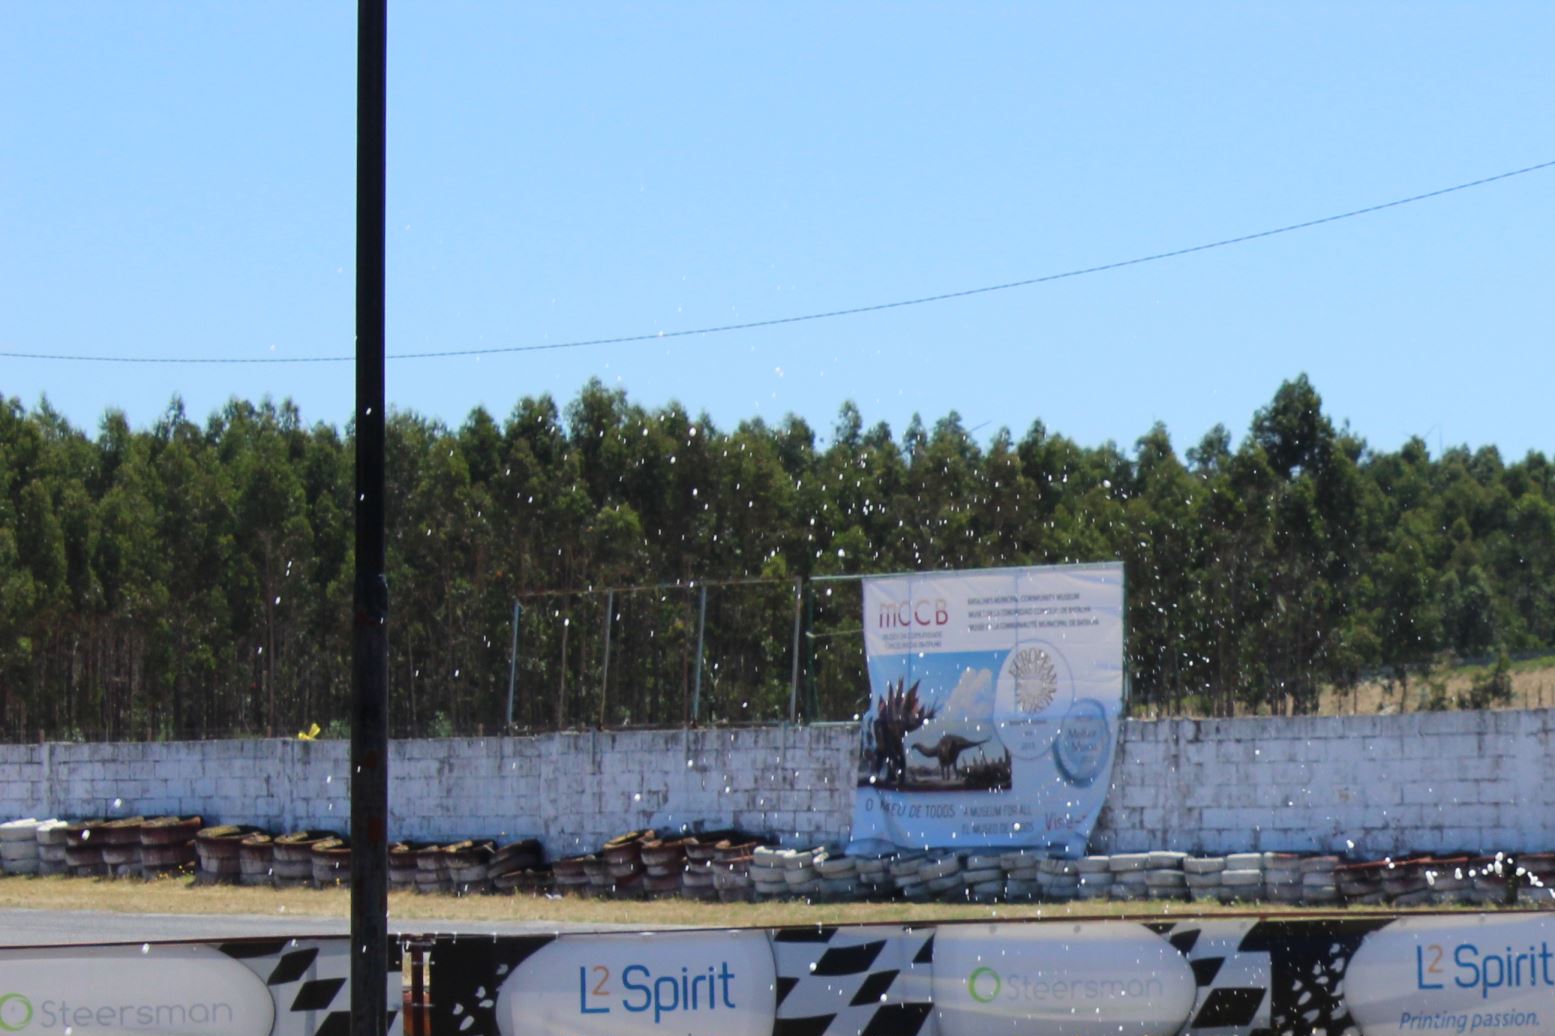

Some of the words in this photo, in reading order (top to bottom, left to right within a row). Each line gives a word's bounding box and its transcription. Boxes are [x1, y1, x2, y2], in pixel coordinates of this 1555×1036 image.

[1454, 941, 1555, 999] Spirit
[622, 961, 736, 1024] Spirit
[1007, 973, 1164, 1000] Steersman
[41, 1000, 233, 1028] Steersman
[1399, 1010, 1468, 1034] Printing
[1471, 1008, 1540, 1032] passion.
